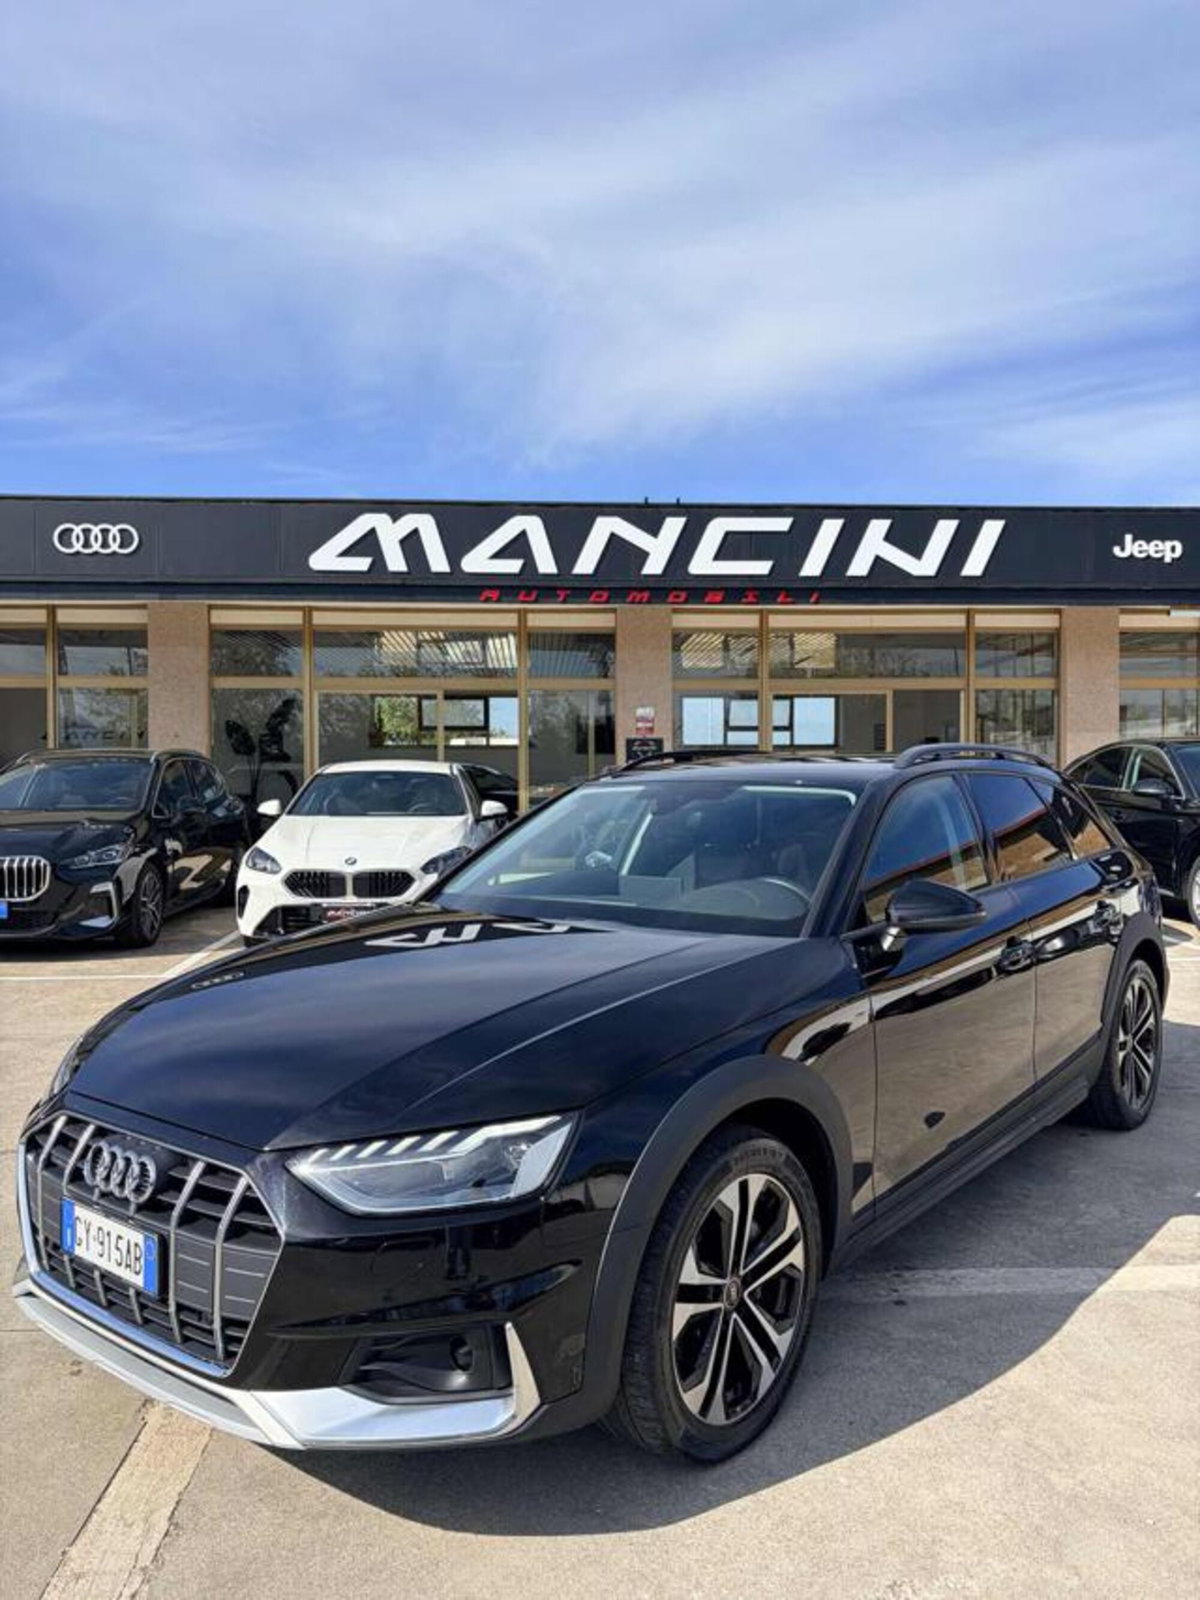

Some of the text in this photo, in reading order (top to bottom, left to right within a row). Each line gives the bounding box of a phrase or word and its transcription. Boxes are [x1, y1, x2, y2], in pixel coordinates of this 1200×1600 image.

[308, 512, 1006, 578] MANCINI
[1112, 533, 1183, 563] Jeep
[478, 589, 820, 604] AUTOMOBILI
